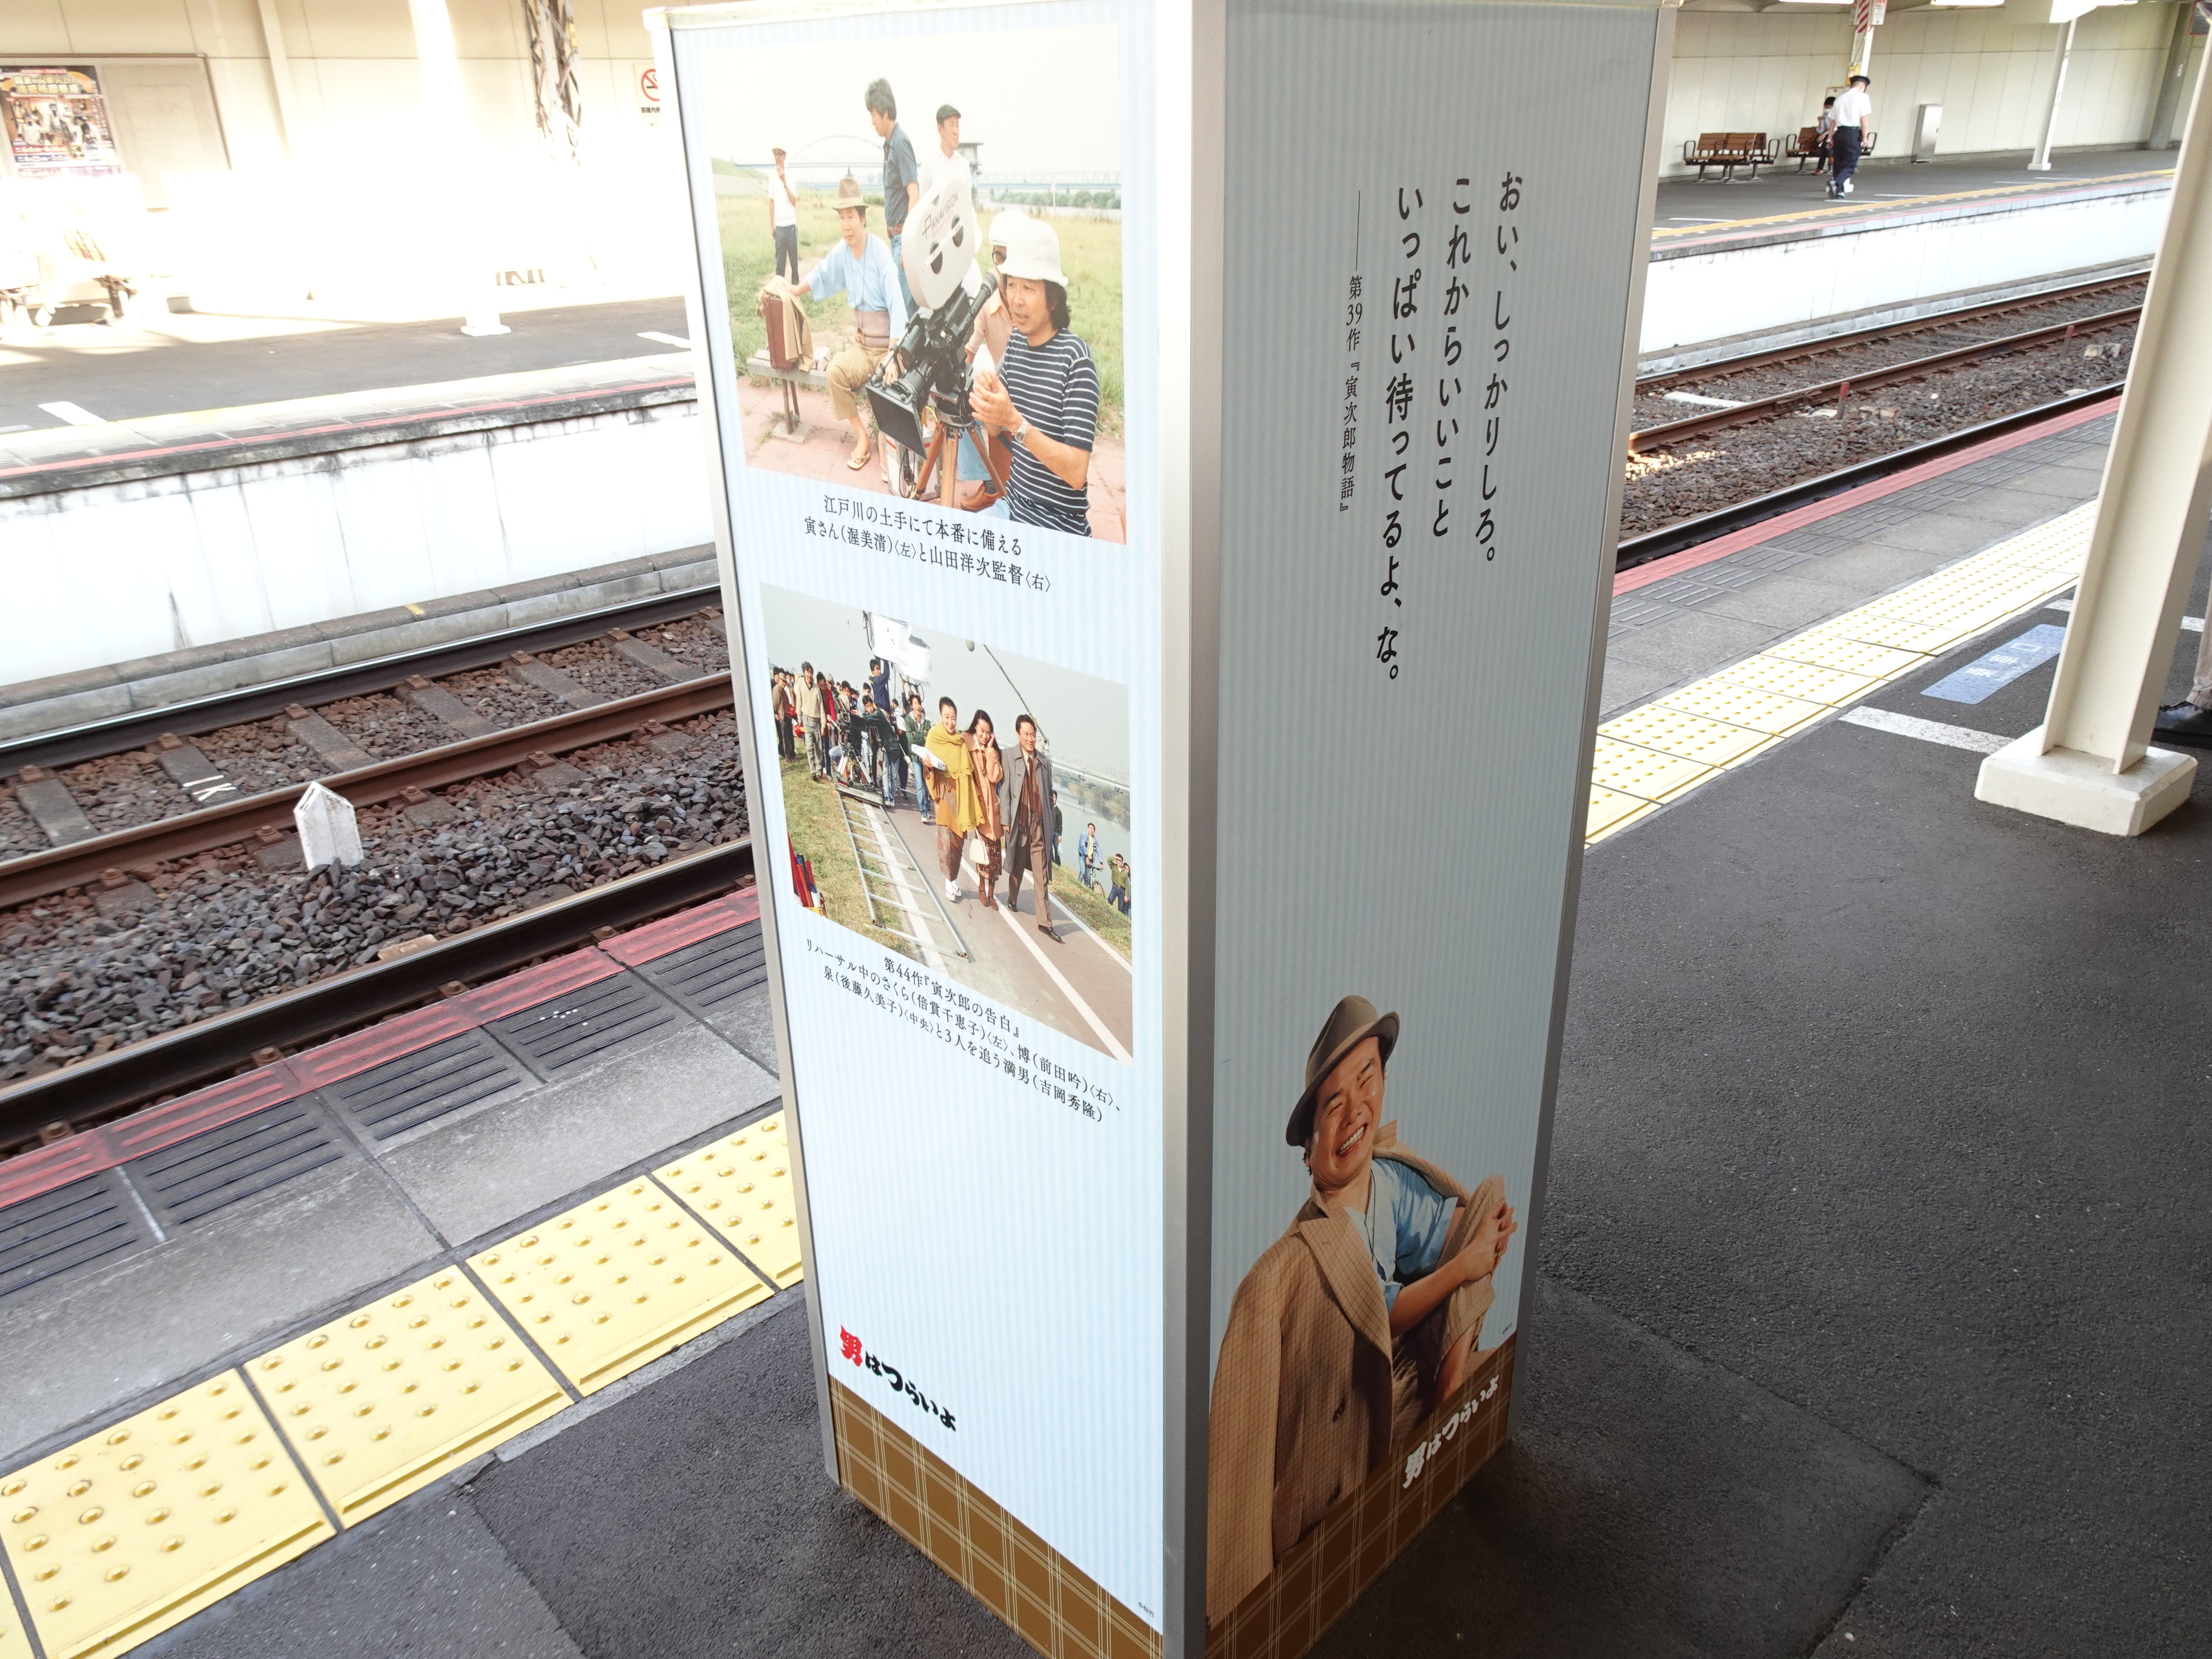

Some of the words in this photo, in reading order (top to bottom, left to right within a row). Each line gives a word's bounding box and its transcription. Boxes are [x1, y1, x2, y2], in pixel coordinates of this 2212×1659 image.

[1433, 178, 1471, 538] これからいいこと
[1475, 171, 1523, 561] おい、しっかりしろ。
[1376, 187, 1423, 680] いっぱい待ってるよ、な。
[823, 494, 1022, 556] 江戸川の土手にて本番に備える
[883, 956, 1020, 1038] 第44作『寅次郎の告白』
[839, 1324, 956, 1432] 男はつらいよ
[1402, 1374, 1500, 1489] 男はつらいよ
